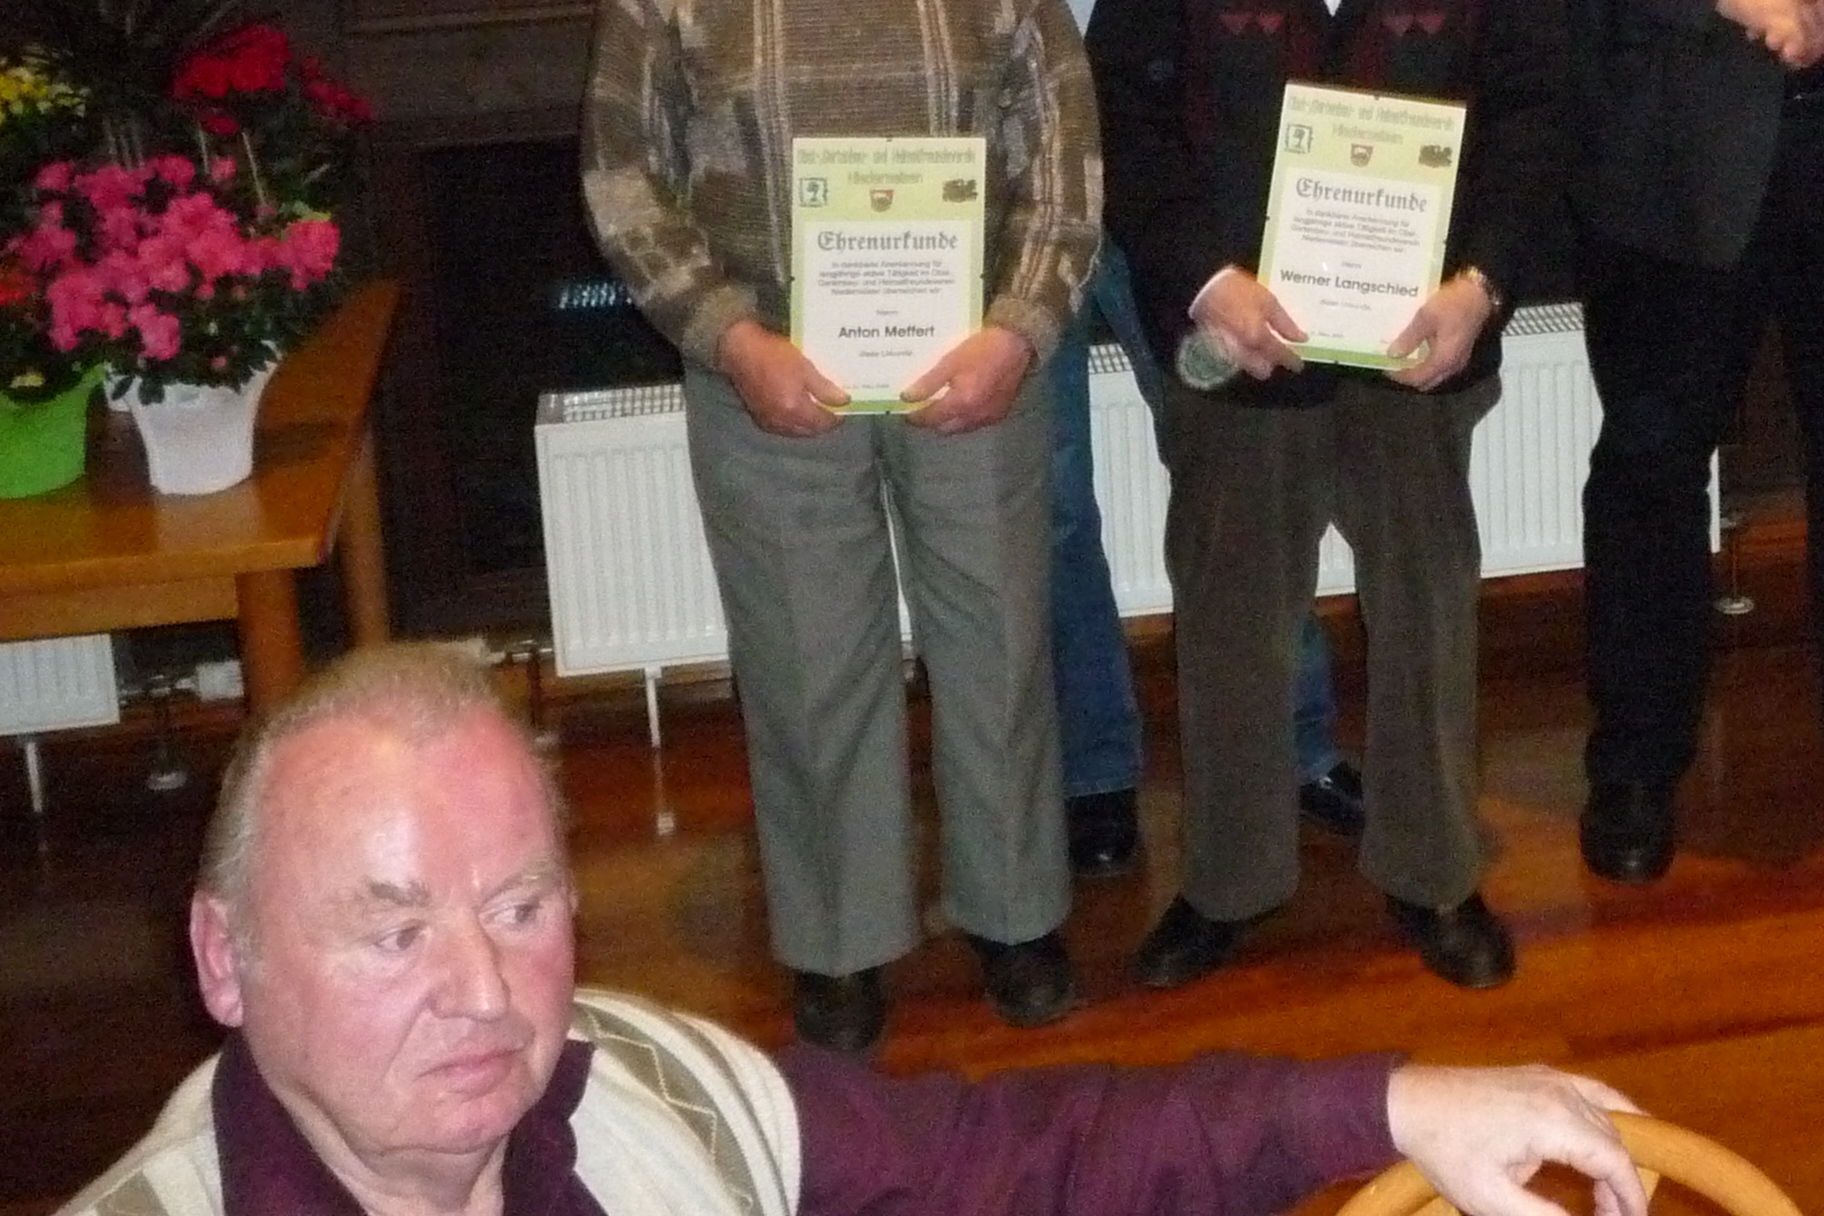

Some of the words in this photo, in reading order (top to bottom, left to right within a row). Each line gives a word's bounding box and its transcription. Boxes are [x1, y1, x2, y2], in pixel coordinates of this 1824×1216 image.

[1296, 177, 1428, 213] Ehrenurkunde
[817, 230, 959, 254] Ehrenurkunde
[1280, 269, 1331, 287] Werner
[1335, 276, 1420, 298] Langschied
[838, 327, 880, 339] Anton
[884, 325, 935, 338] Meffert
